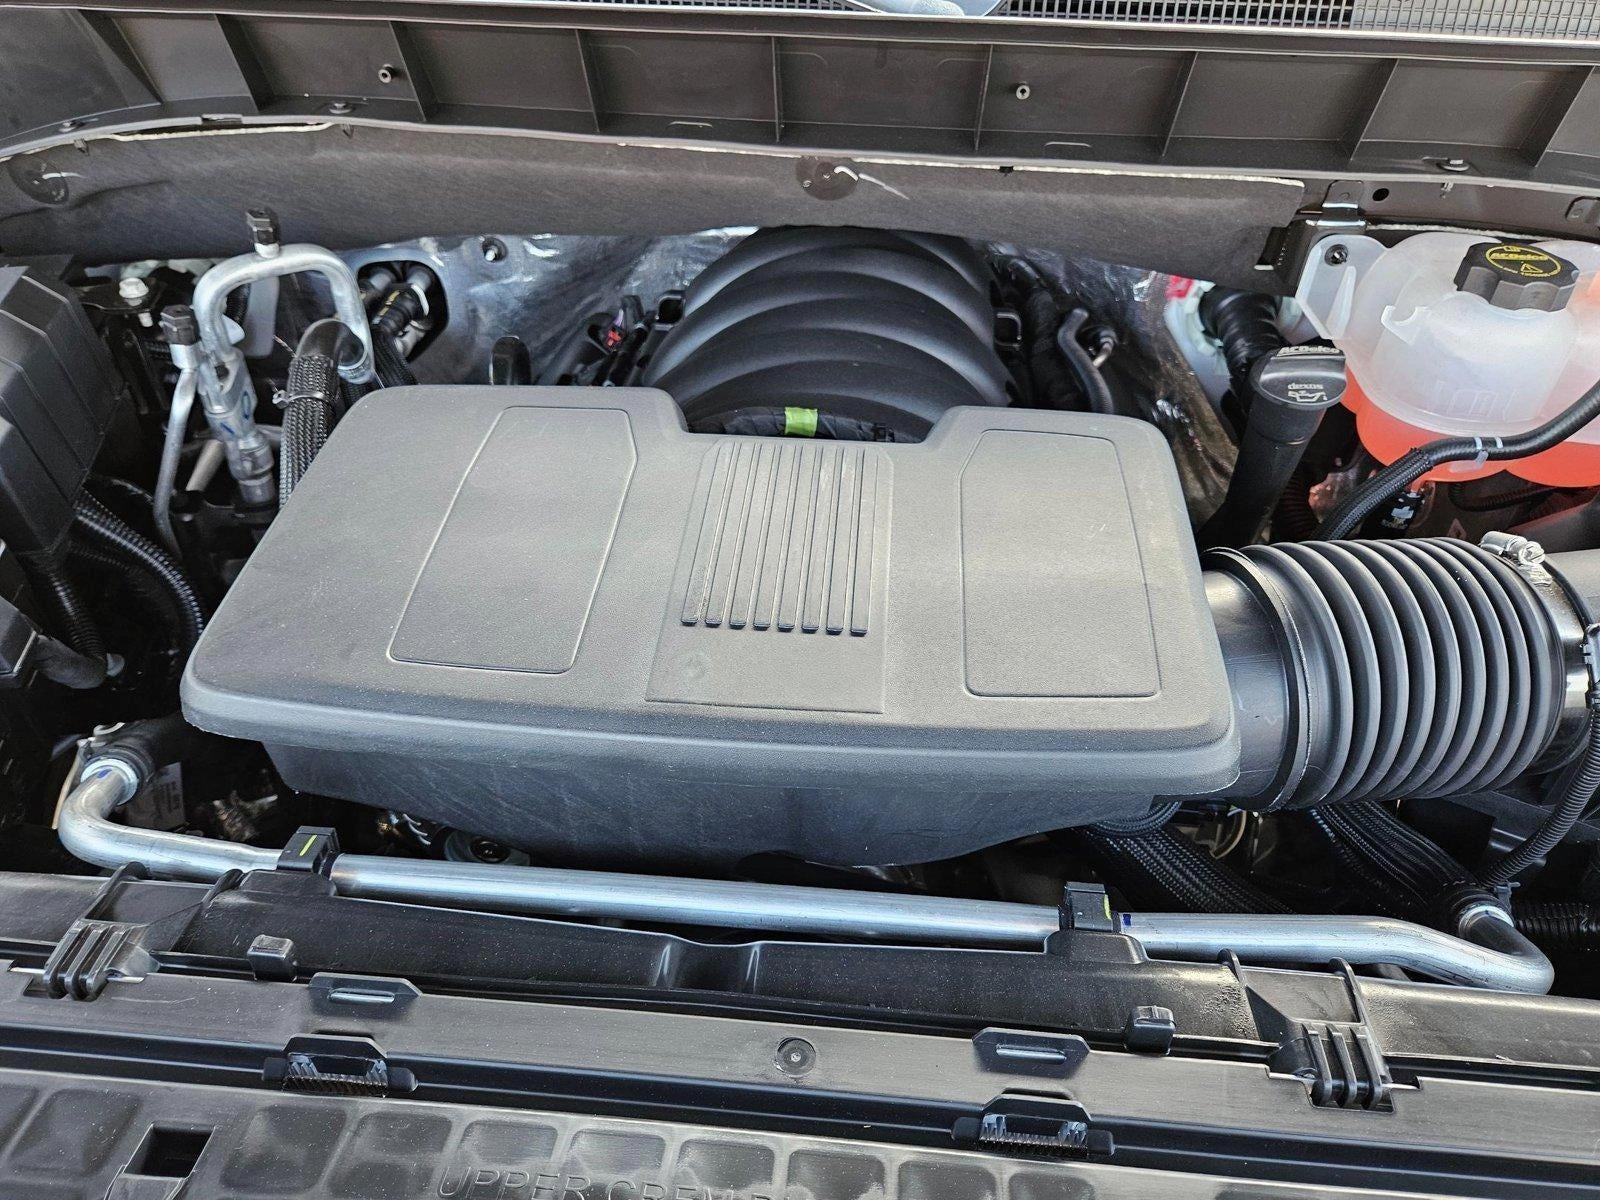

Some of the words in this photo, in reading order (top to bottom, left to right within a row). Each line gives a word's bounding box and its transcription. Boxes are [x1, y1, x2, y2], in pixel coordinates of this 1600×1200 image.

[1277, 346, 1340, 356] ACDelco
[1288, 382, 1324, 390] dexos
[437, 1166, 591, 1200] UPPER
